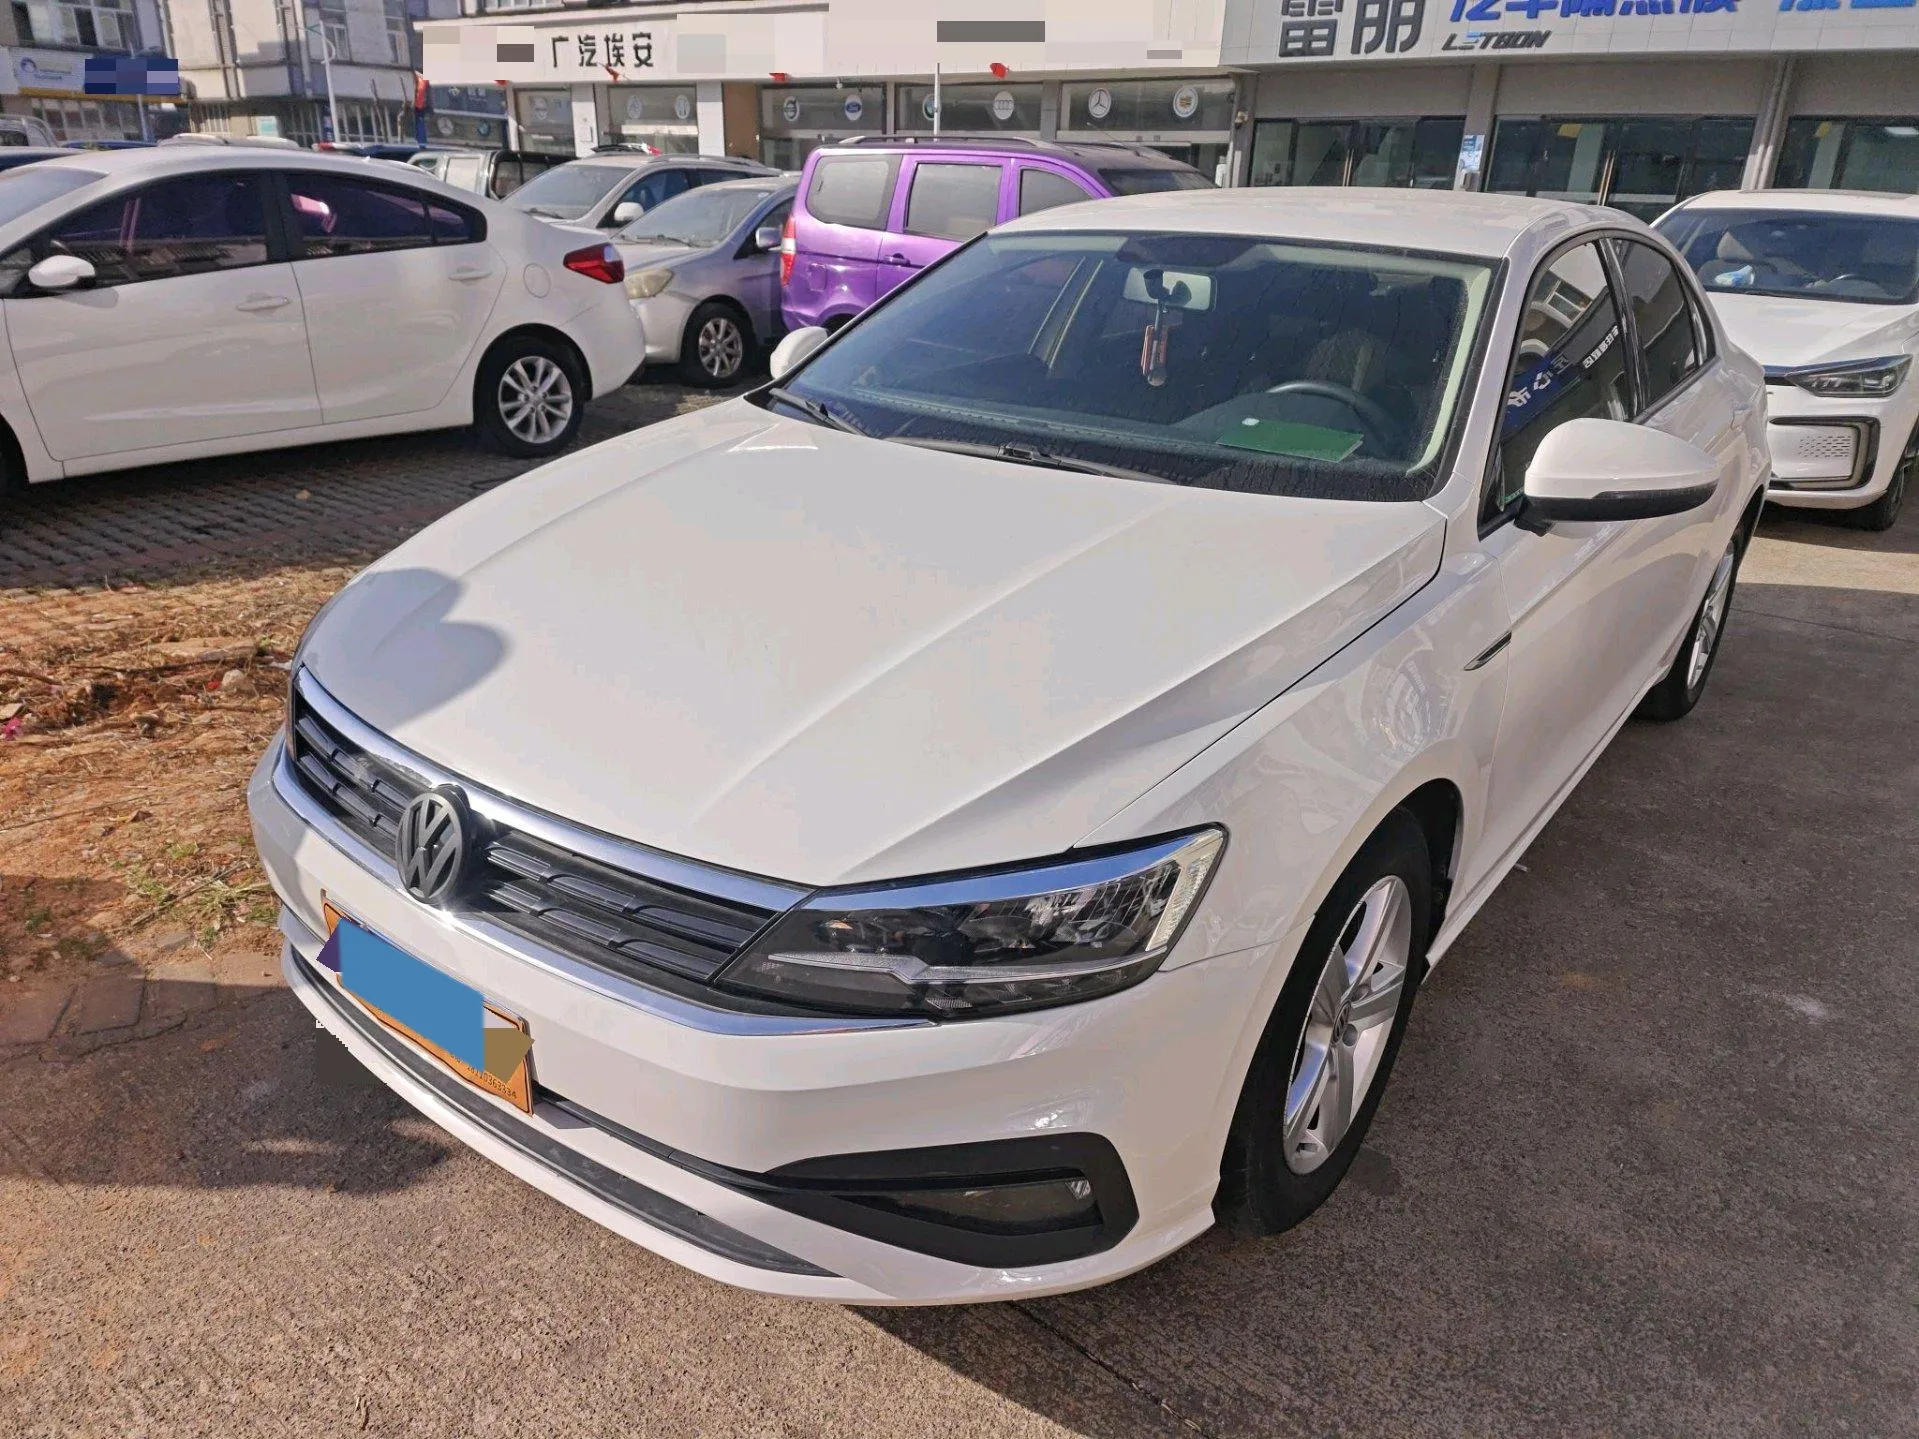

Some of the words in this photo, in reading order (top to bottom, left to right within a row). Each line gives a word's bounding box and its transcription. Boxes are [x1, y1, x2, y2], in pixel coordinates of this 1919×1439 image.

[551, 32, 654, 68] 广汽埃安
[1441, 30, 1552, 50] LETBON
